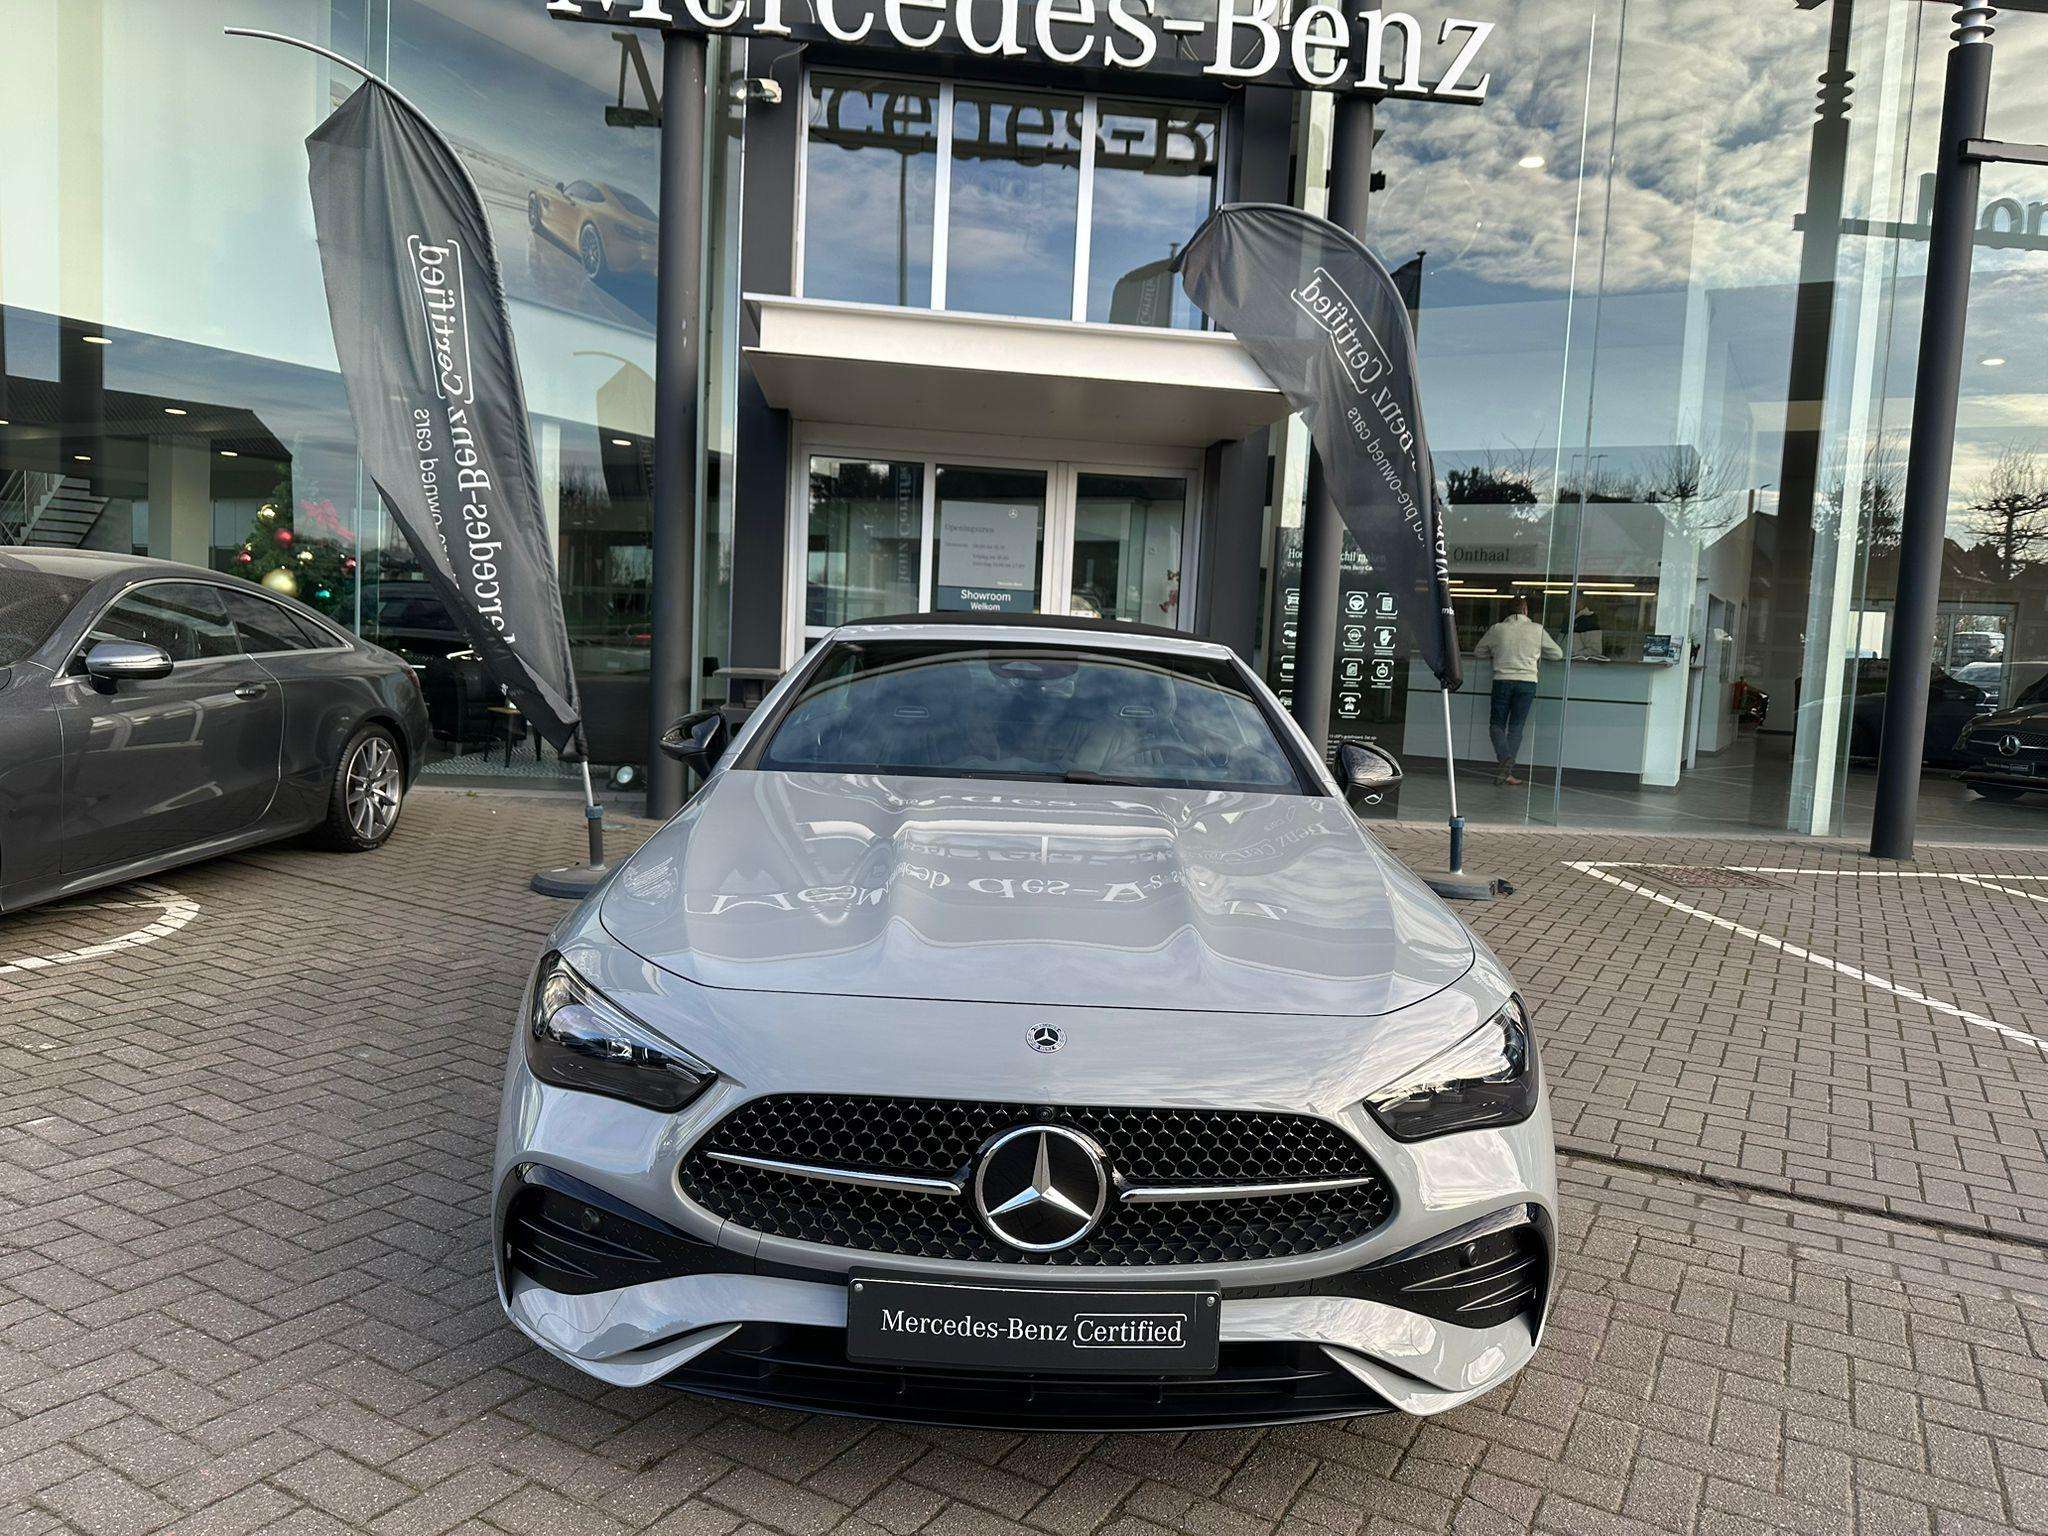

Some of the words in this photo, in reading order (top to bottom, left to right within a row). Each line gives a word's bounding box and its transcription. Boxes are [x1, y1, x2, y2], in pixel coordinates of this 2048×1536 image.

[546, 0, 1496, 98] cees-Benz
[1453, 547, 1510, 562] Onthaal
[960, 589, 1011, 602] Showroom
[970, 601, 1001, 611] Welkom
[881, 1308, 1068, 1341] Mercedes-Benz
[1077, 1320, 1183, 1343] Certified
